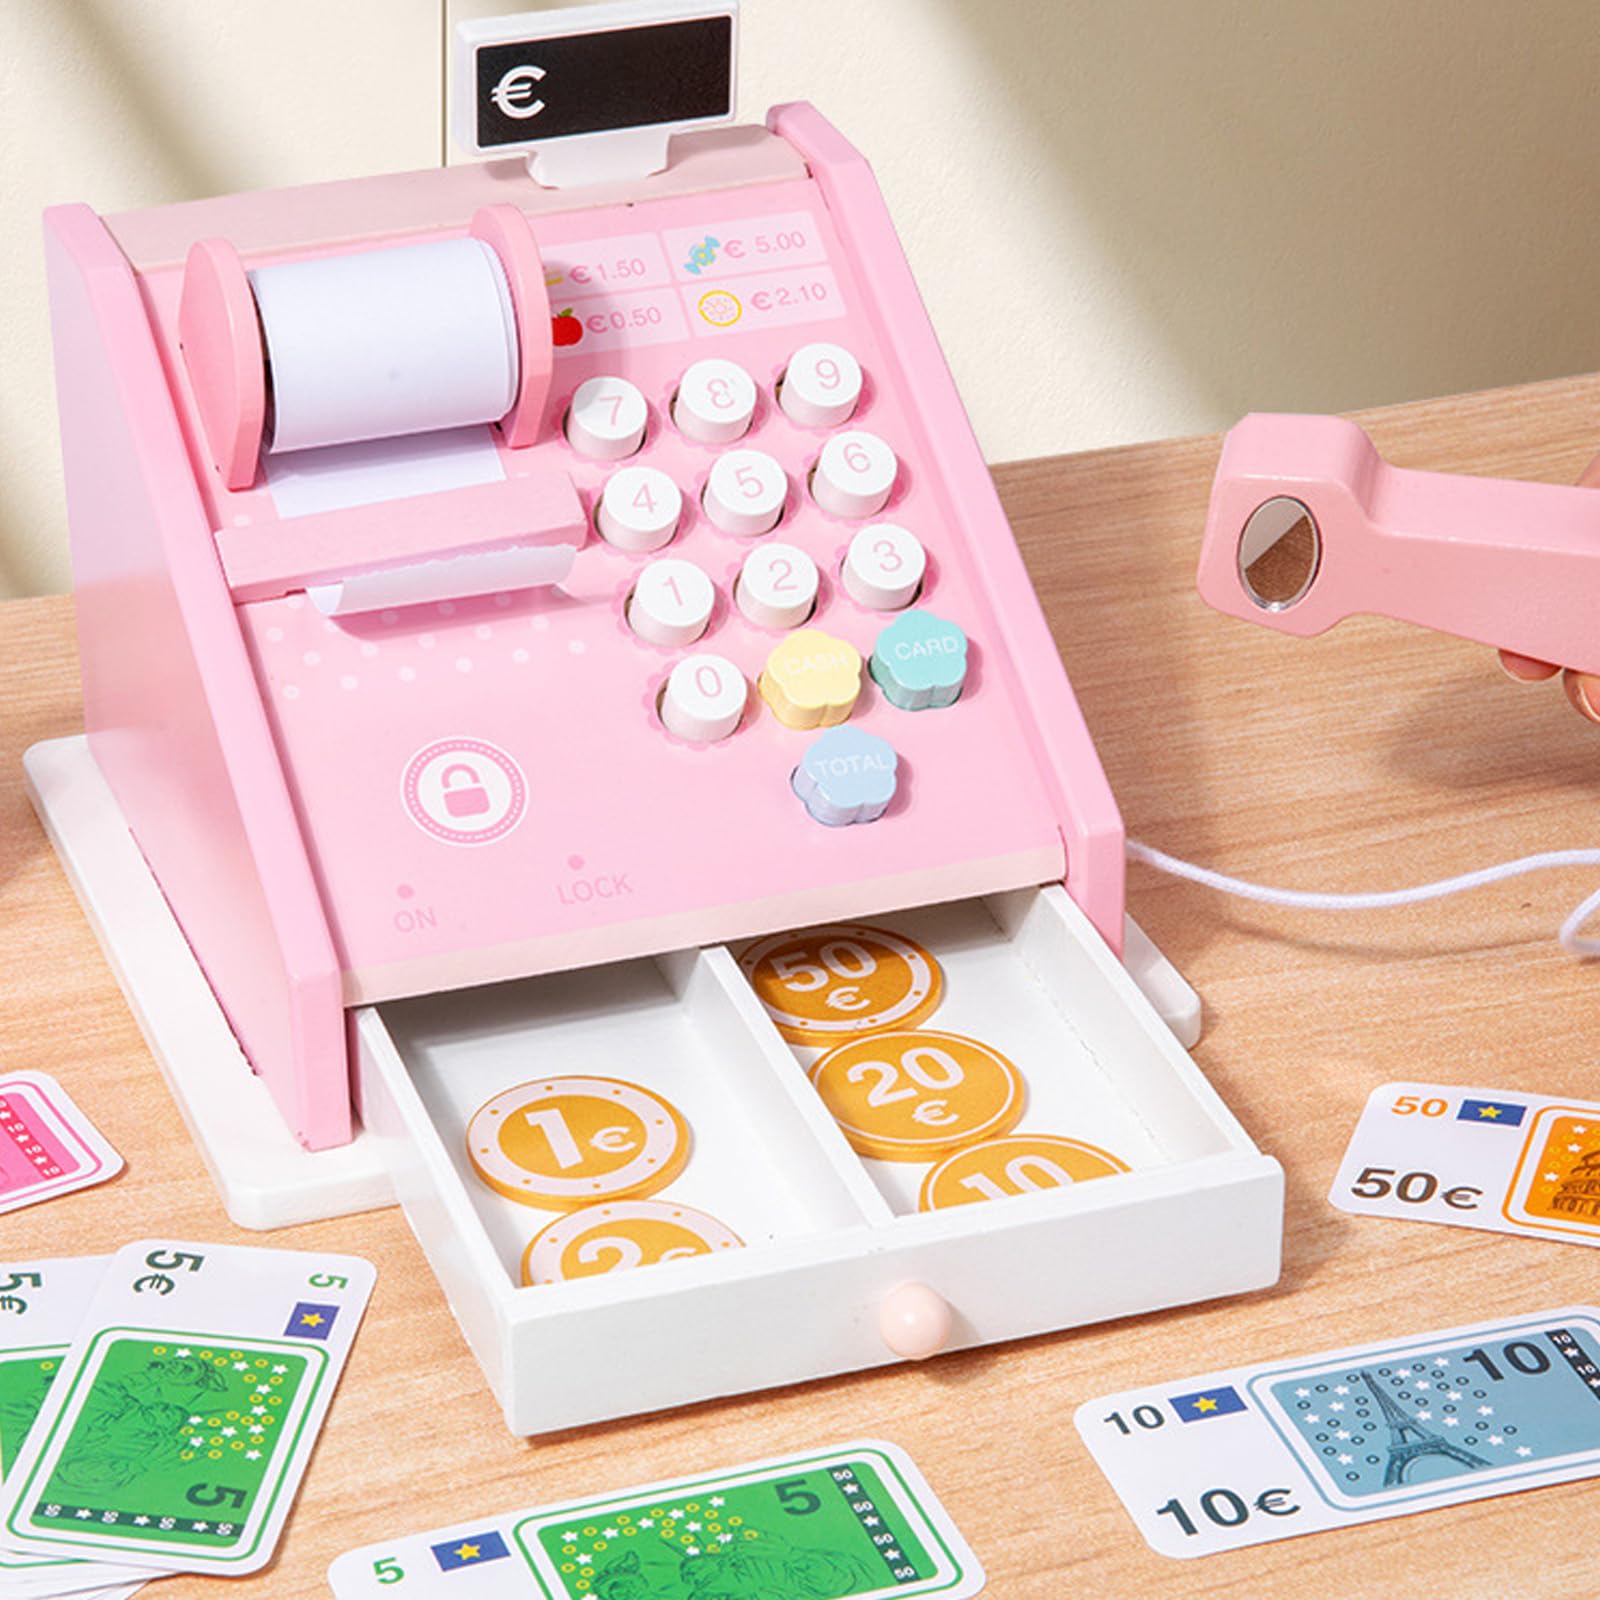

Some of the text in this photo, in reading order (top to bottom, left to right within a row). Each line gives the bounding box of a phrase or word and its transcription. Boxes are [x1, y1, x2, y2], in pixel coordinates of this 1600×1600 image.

[491, 65, 547, 119] €
[751, 282, 827, 310] €2.10
[586, 306, 663, 333] €0.50
[599, 395, 624, 426] 7
[815, 358, 841, 390] 9
[631, 442, 872, 513] 4 5 6
[662, 540, 903, 607] 1 2 3
[695, 636, 959, 698] 0 CASH CARD
[814, 754, 892, 776] TOTAL
[556, 873, 633, 905] LOCK
[394, 907, 437, 933] ON
[769, 940, 877, 992] 50
[826, 986, 870, 1011] €
[846, 1047, 965, 1108] 20
[911, 1099, 959, 1126] €
[1391, 1096, 1448, 1117] 50
[959, 1155, 1074, 1201] 10
[1350, 1167, 1484, 1210] 50€
[133, 1250, 204, 1295] 5€
[309, 1273, 348, 1289] 5
[1552, 1333, 1571, 1345] 10
[1462, 1341, 1551, 1381] 10
[1577, 1362, 1596, 1375] 10
[1103, 1405, 1164, 1435] 10
[832, 1469, 853, 1481] 50
[186, 1483, 247, 1509] 5
[774, 1479, 821, 1516] 5
[853, 1501, 873, 1513] 50
[1157, 1487, 1301, 1537] 10€
[873, 1533, 894, 1545] 50
[373, 1557, 404, 1584] 5
[894, 1566, 915, 1579] 50
